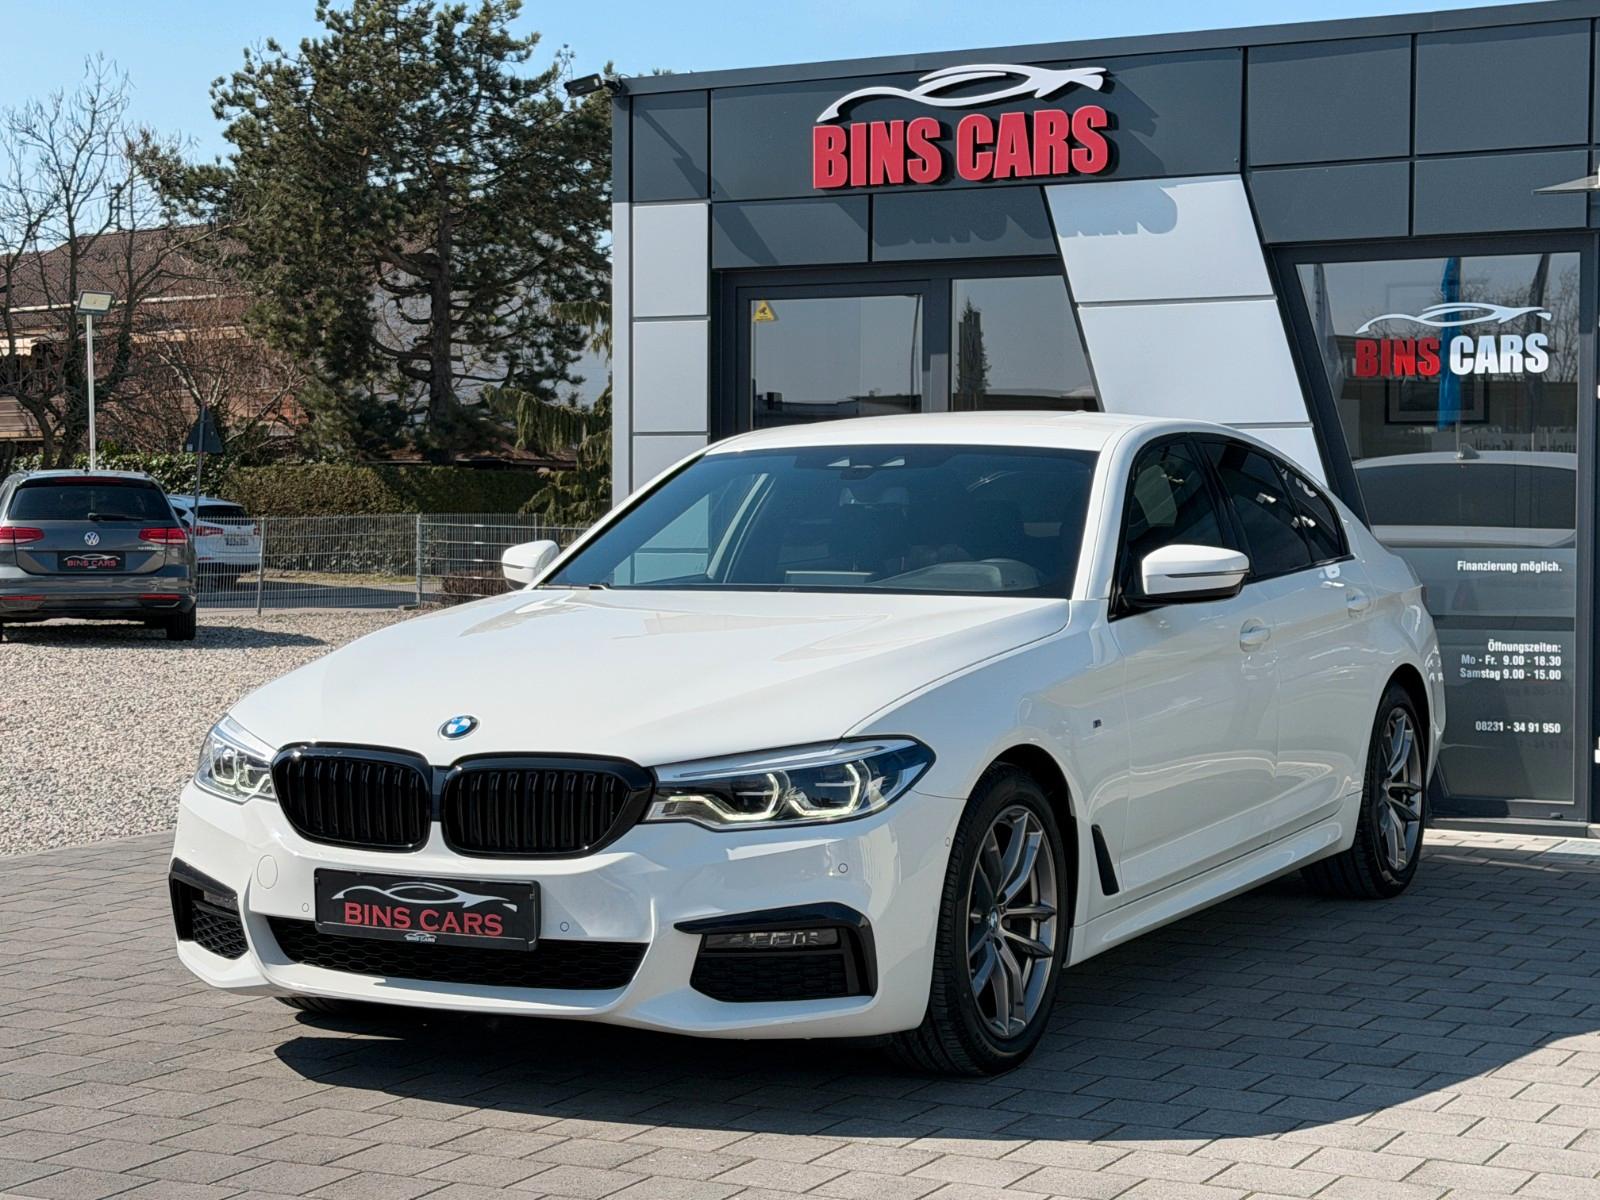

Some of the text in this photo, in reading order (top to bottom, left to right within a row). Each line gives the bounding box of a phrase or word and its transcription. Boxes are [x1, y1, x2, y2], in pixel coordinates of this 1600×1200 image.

[813, 105, 1109, 189] BINS CARS
[1355, 332, 1549, 377] BINS CARS
[1457, 560, 1562, 573] Finanzierung möglich.
[1488, 639, 1562, 654] Öffnungszeiten:
[1461, 654, 1476, 665] Mo
[1485, 654, 1498, 665] Fr.
[1503, 655, 1524, 666] 9.00
[1534, 655, 1561, 666] 18.30
[1459, 668, 1501, 681] Samstag
[1503, 669, 1524, 679] 9.00
[1534, 669, 1561, 680] 15.00
[1475, 721, 1504, 732] 08231
[1513, 722, 1526, 732] 34
[1528, 722, 1539, 732] 91
[1543, 722, 1561, 733] 950
[344, 902, 503, 937] BINS CARS
